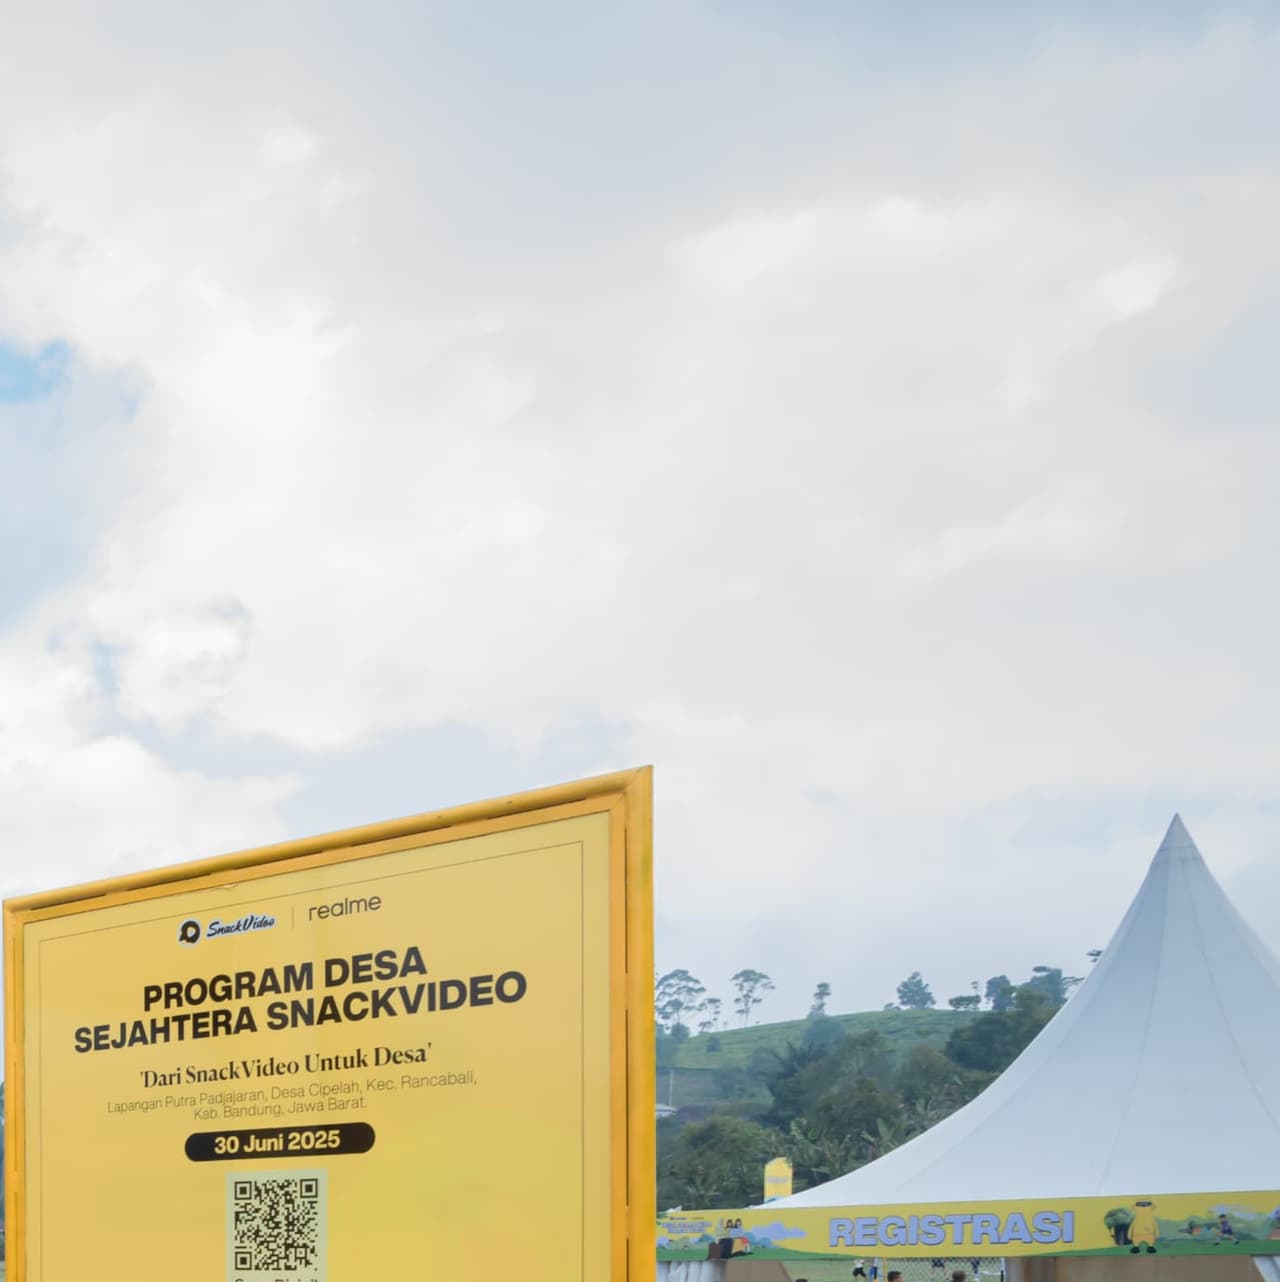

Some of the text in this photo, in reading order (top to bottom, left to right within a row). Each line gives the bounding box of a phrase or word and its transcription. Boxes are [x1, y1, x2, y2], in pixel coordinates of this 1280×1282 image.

[308, 895, 383, 922] realme
[205, 914, 276, 938] SnackVideo
[143, 946, 428, 1012] PROGRAM DESA
[74, 970, 528, 1054] SEJAHTERA SNACKVIDEO
[304, 1047, 369, 1073] Untuk
[373, 1041, 432, 1067] Desa'
[107, 1070, 478, 1114] Lapangan Putra Padjajaran, Desa Cipelah, Kec. Rancabali,
[193, 1095, 368, 1120] Kab. Bandung, Jawa Barat.
[213, 1129, 341, 1155] 30 Juni 2025
[828, 1210, 1075, 1247] REGISTRASI
